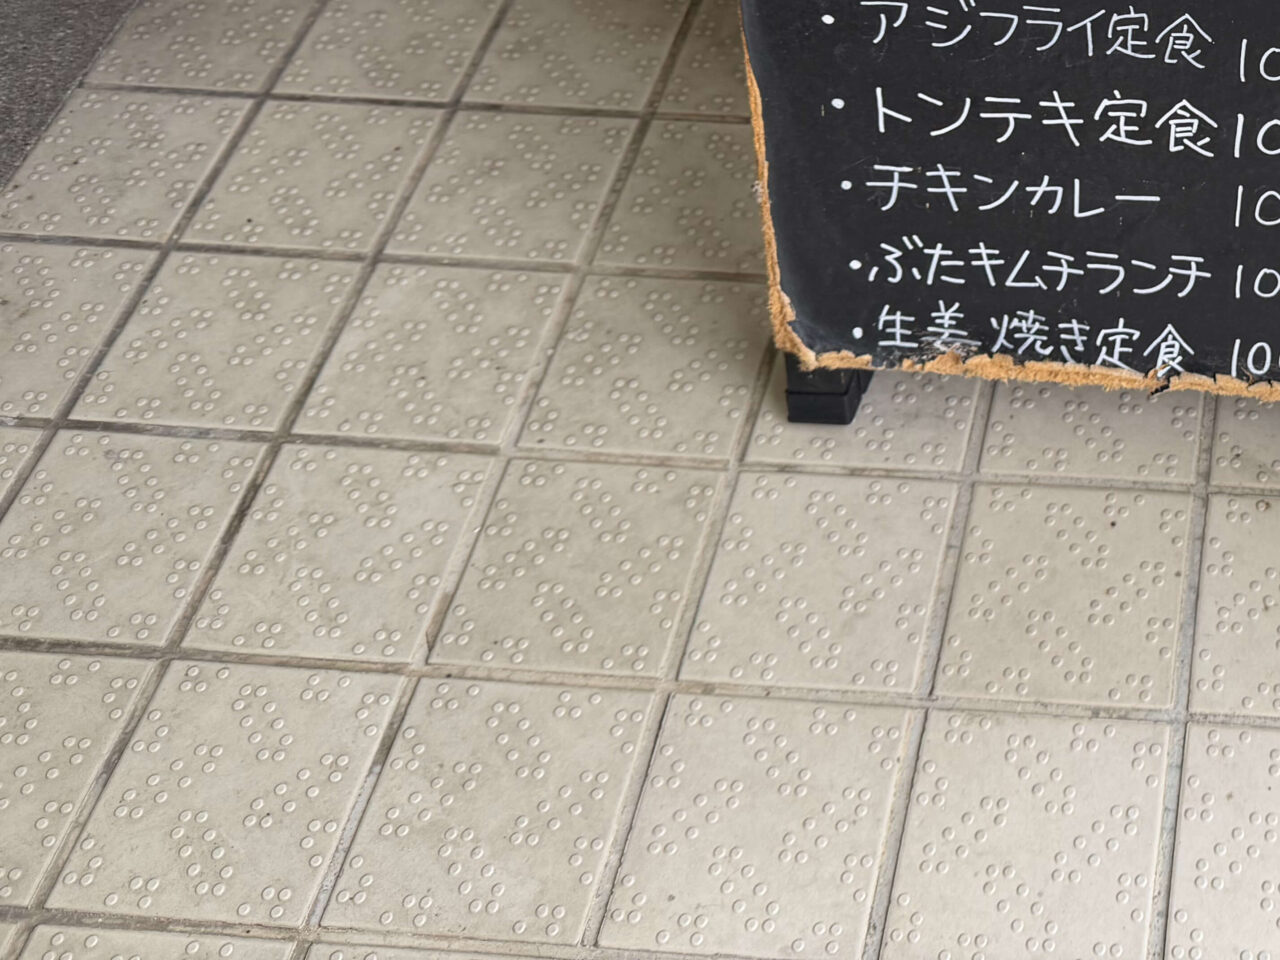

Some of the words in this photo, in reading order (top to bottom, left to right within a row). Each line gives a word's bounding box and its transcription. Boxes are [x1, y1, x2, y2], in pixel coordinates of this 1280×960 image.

[875, 86, 1219, 158] トンテキ定食
[865, 163, 1161, 218] チキンカレー
